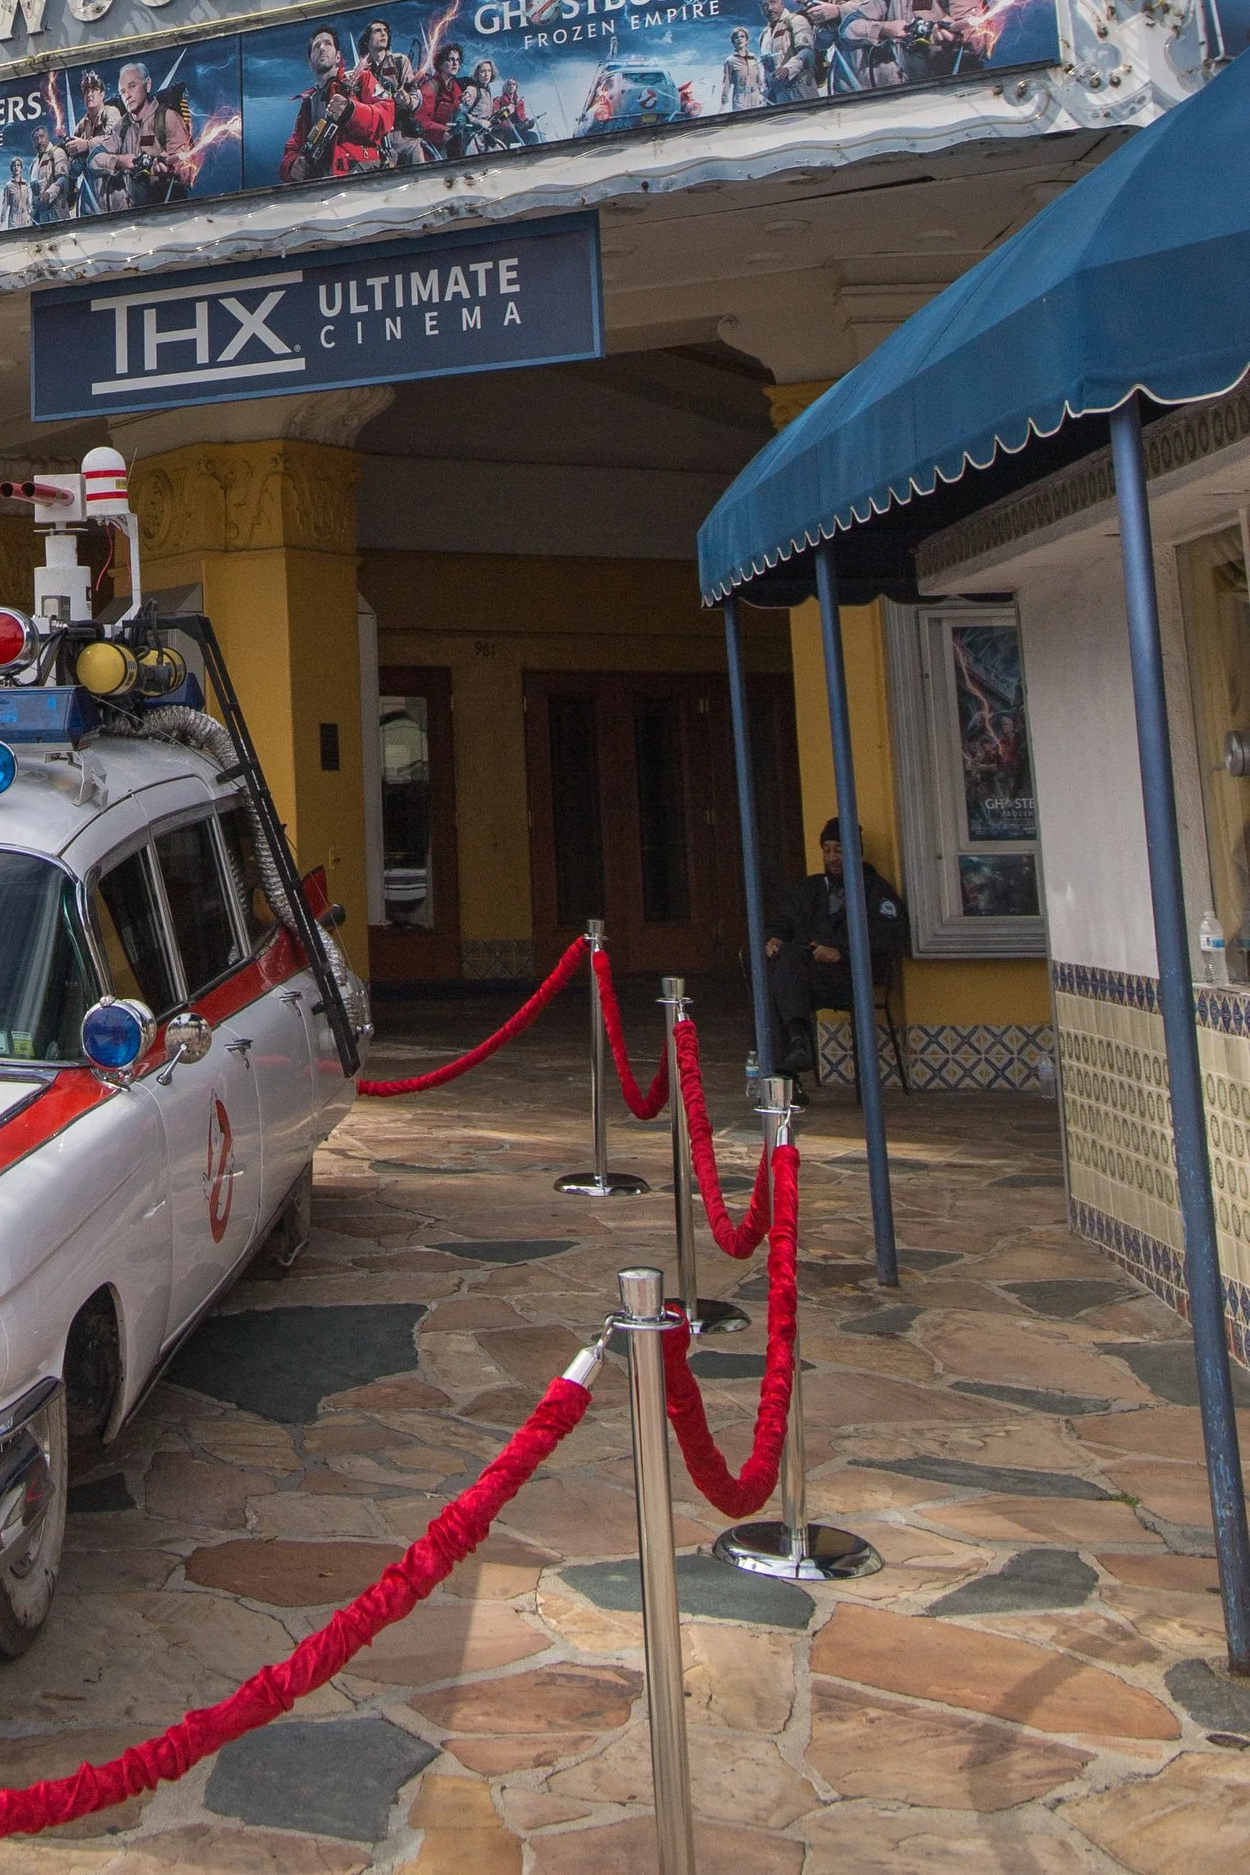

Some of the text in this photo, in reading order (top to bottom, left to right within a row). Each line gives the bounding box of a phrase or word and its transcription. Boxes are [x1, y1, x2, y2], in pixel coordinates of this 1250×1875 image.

[524, 0, 721, 51] FROZEN EMPIRE
[318, 257, 522, 318] ULTIMATE
[91, 270, 304, 375] THX
[319, 301, 523, 350] CINEMA
